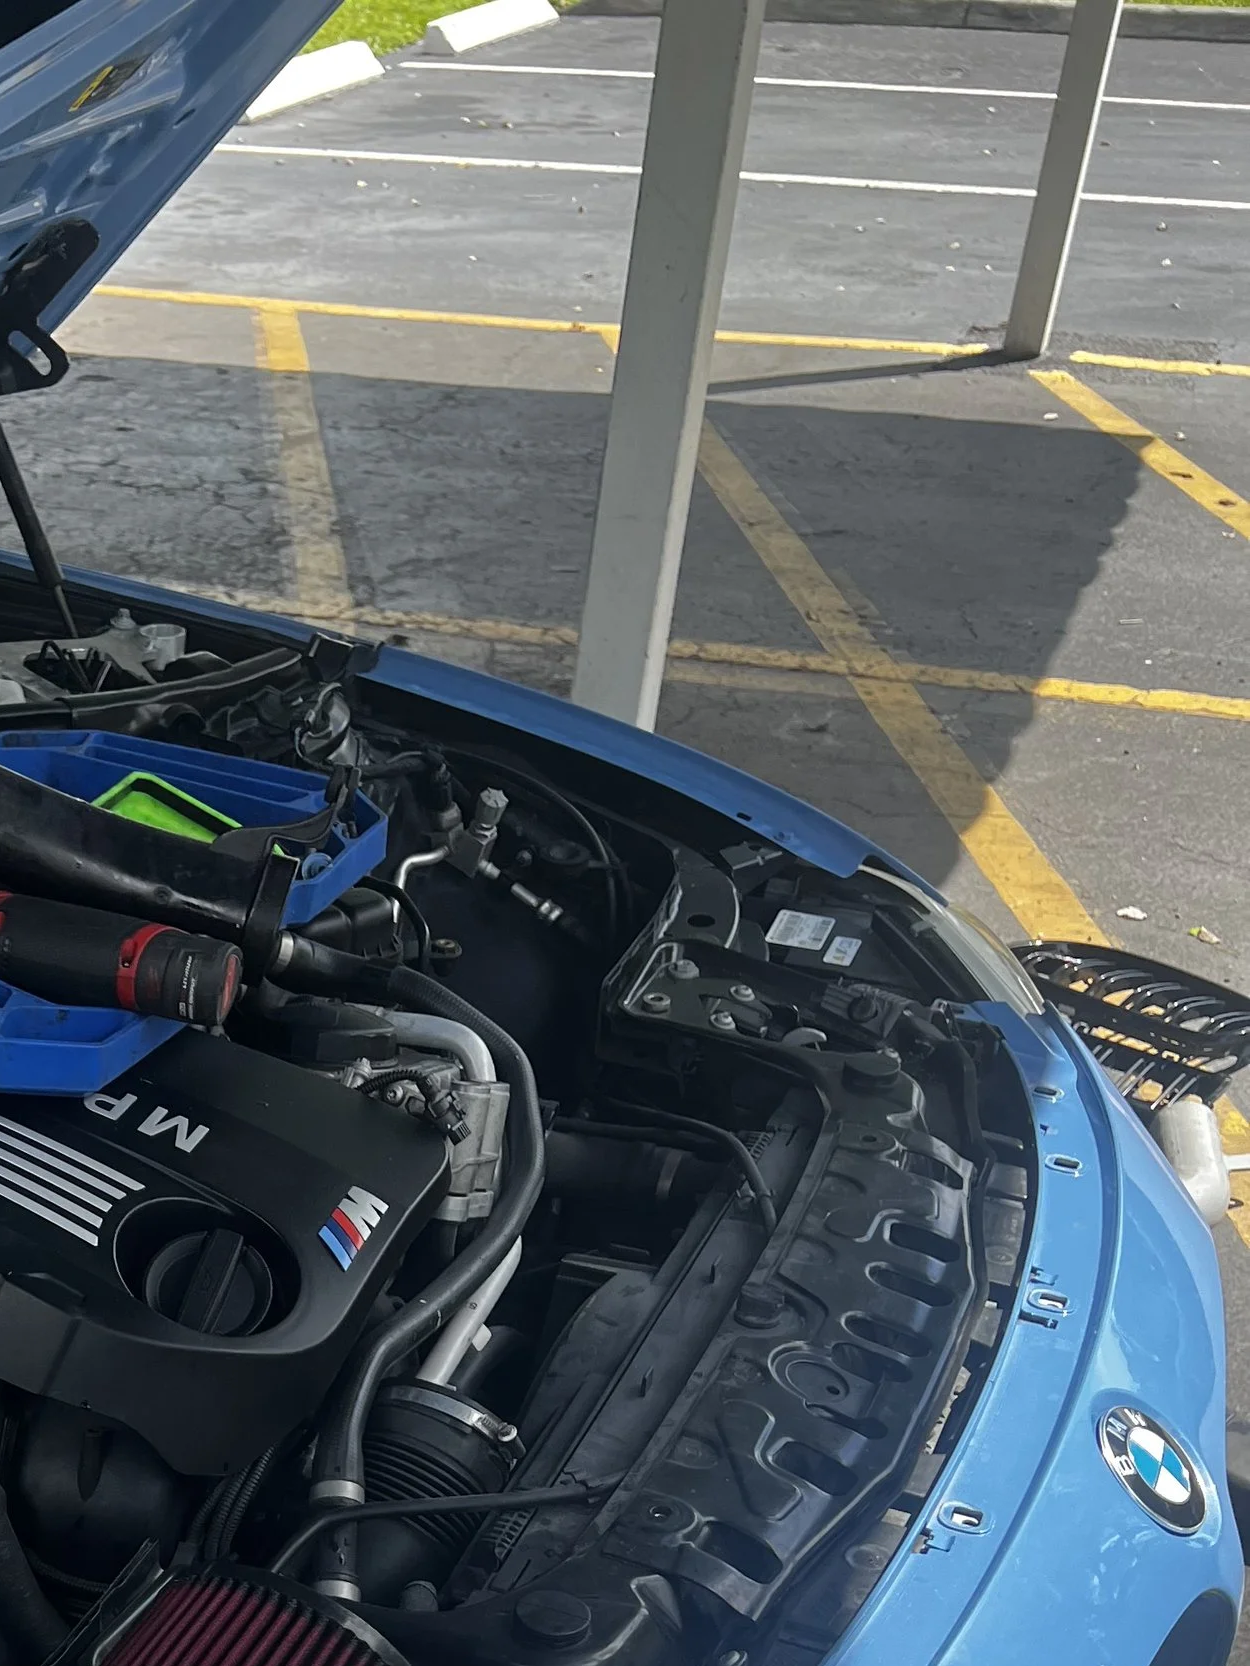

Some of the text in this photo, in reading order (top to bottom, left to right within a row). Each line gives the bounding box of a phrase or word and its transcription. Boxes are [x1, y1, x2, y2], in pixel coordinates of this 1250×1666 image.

[136, 1105, 210, 1153] M
[338, 1185, 390, 1241] M
[1106, 1407, 1147, 1477] BMW
